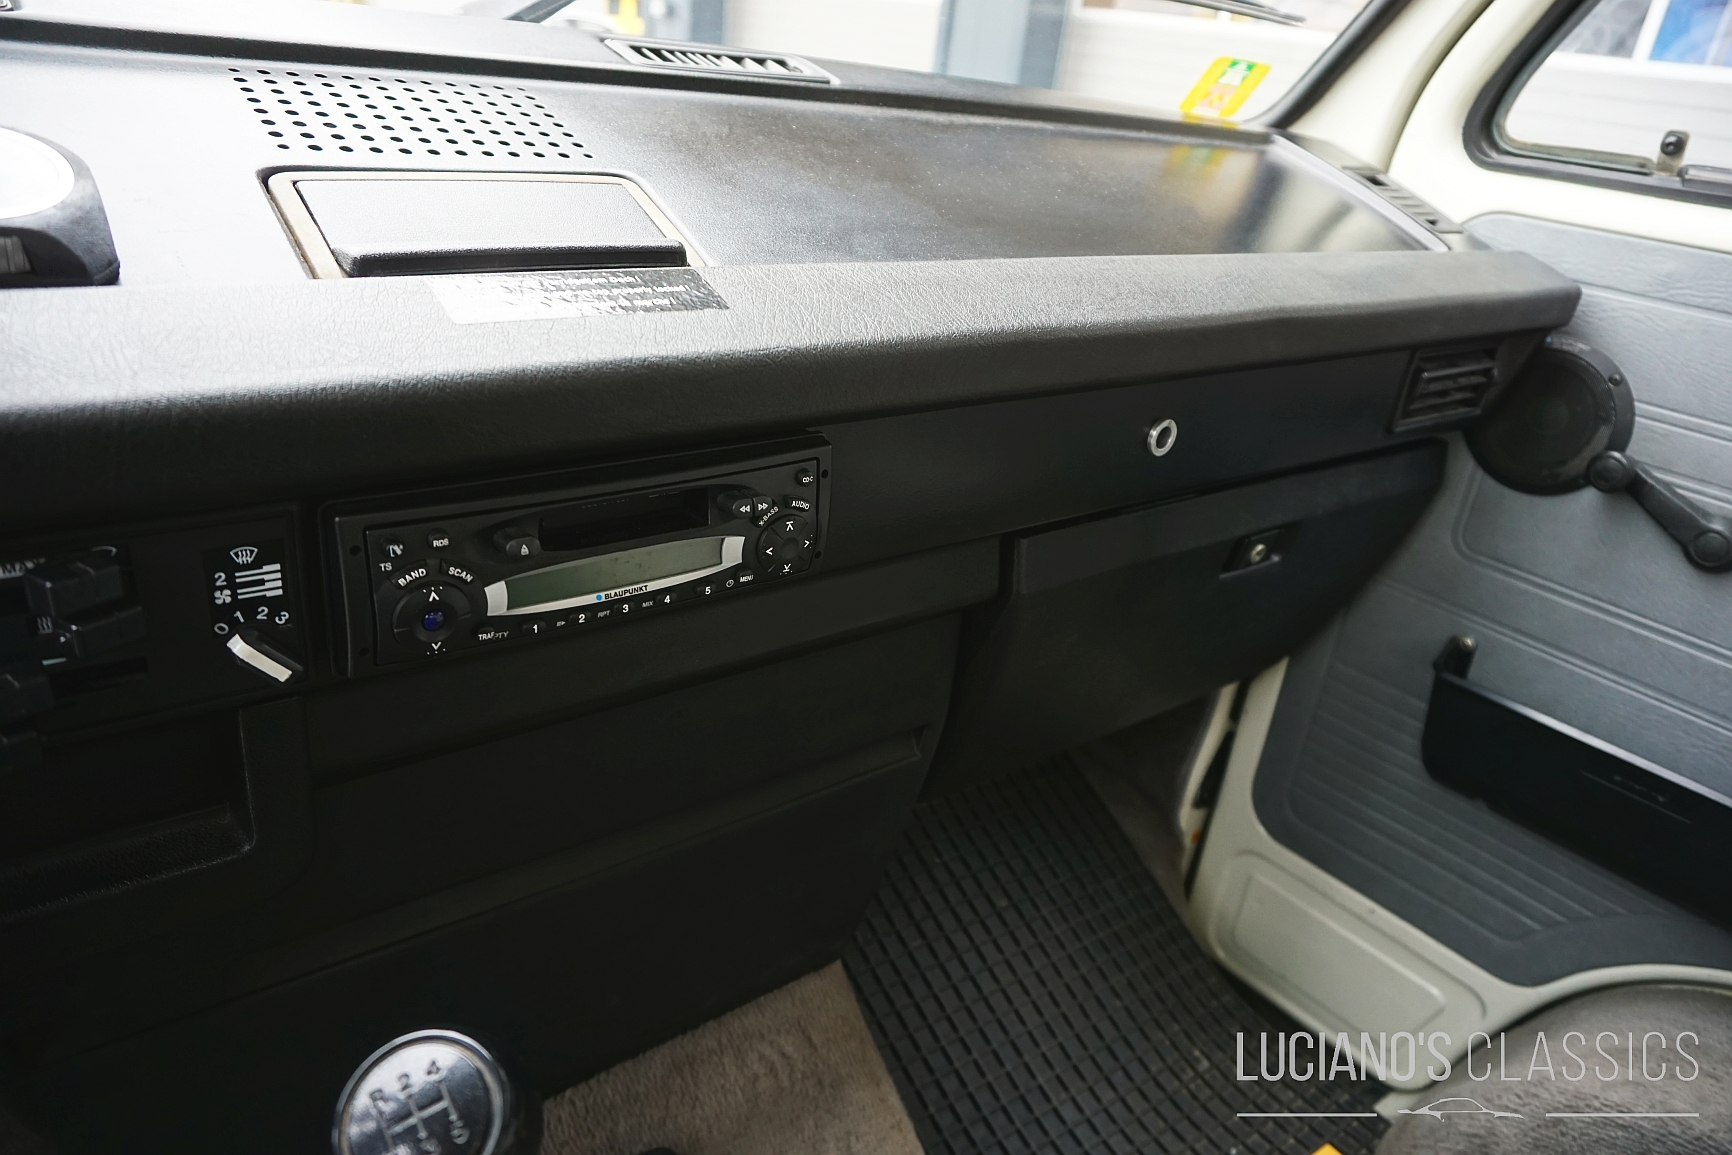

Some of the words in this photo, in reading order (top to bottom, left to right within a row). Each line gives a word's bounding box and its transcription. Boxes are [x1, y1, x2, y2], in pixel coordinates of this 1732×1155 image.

[791, 500, 810, 510] AUDIO
[432, 537, 449, 548] RDS
[379, 562, 392, 572] TS
[213, 572, 227, 587] 2
[397, 568, 427, 587] BAND
[448, 566, 474, 583] SCAN
[739, 574, 754, 583] MENU
[604, 584, 649, 600] BLAUPUNKT
[704, 586, 711, 595] 5
[663, 595, 671, 604] 4
[622, 604, 629, 613] 3
[214, 623, 229, 635] 0
[233, 611, 245, 623] 1
[256, 606, 269, 620] 2
[275, 611, 289, 625] 3
[578, 614, 586, 623] 2
[532, 624, 538, 634] 1
[397, 1072, 416, 1097] 2
[426, 1059, 446, 1080] 4
